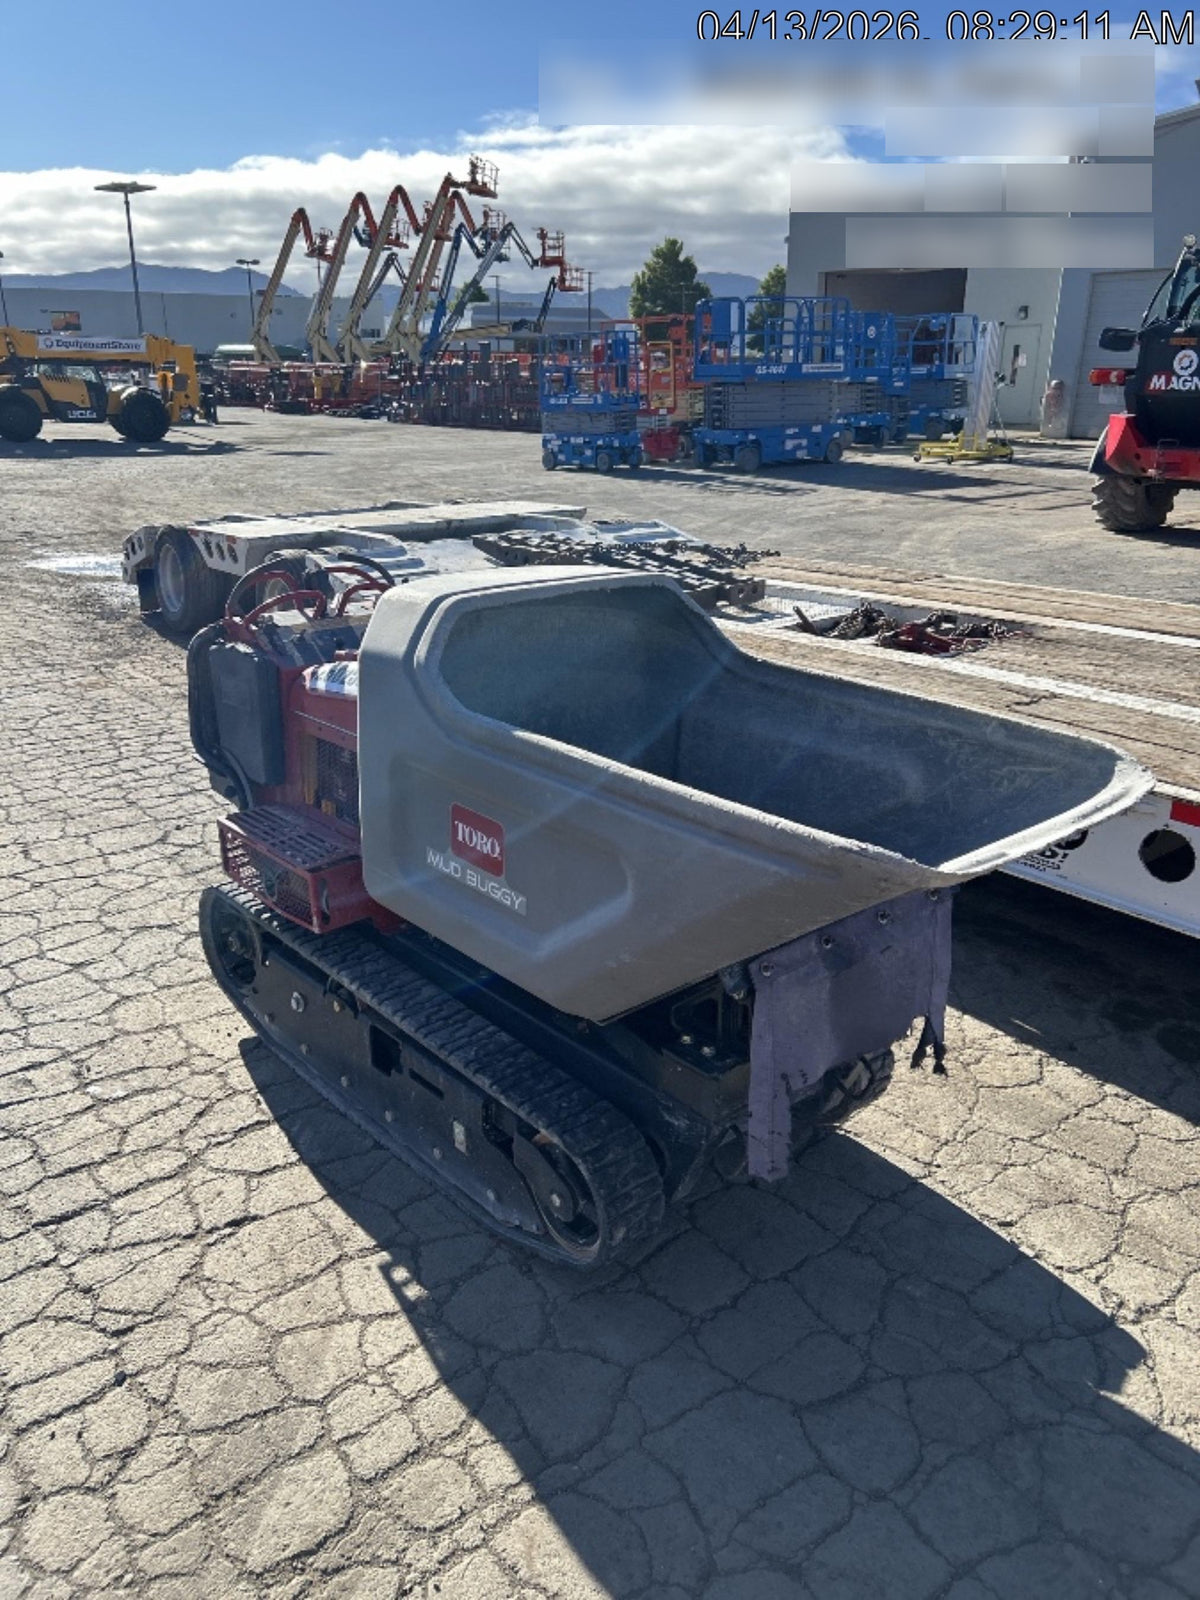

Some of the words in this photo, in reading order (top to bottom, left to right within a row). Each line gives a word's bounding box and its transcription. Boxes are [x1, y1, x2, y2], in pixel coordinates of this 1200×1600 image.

[454, 820, 501, 860] TORO
[426, 848, 462, 878] MUD
[466, 867, 522, 910] BUGGY
